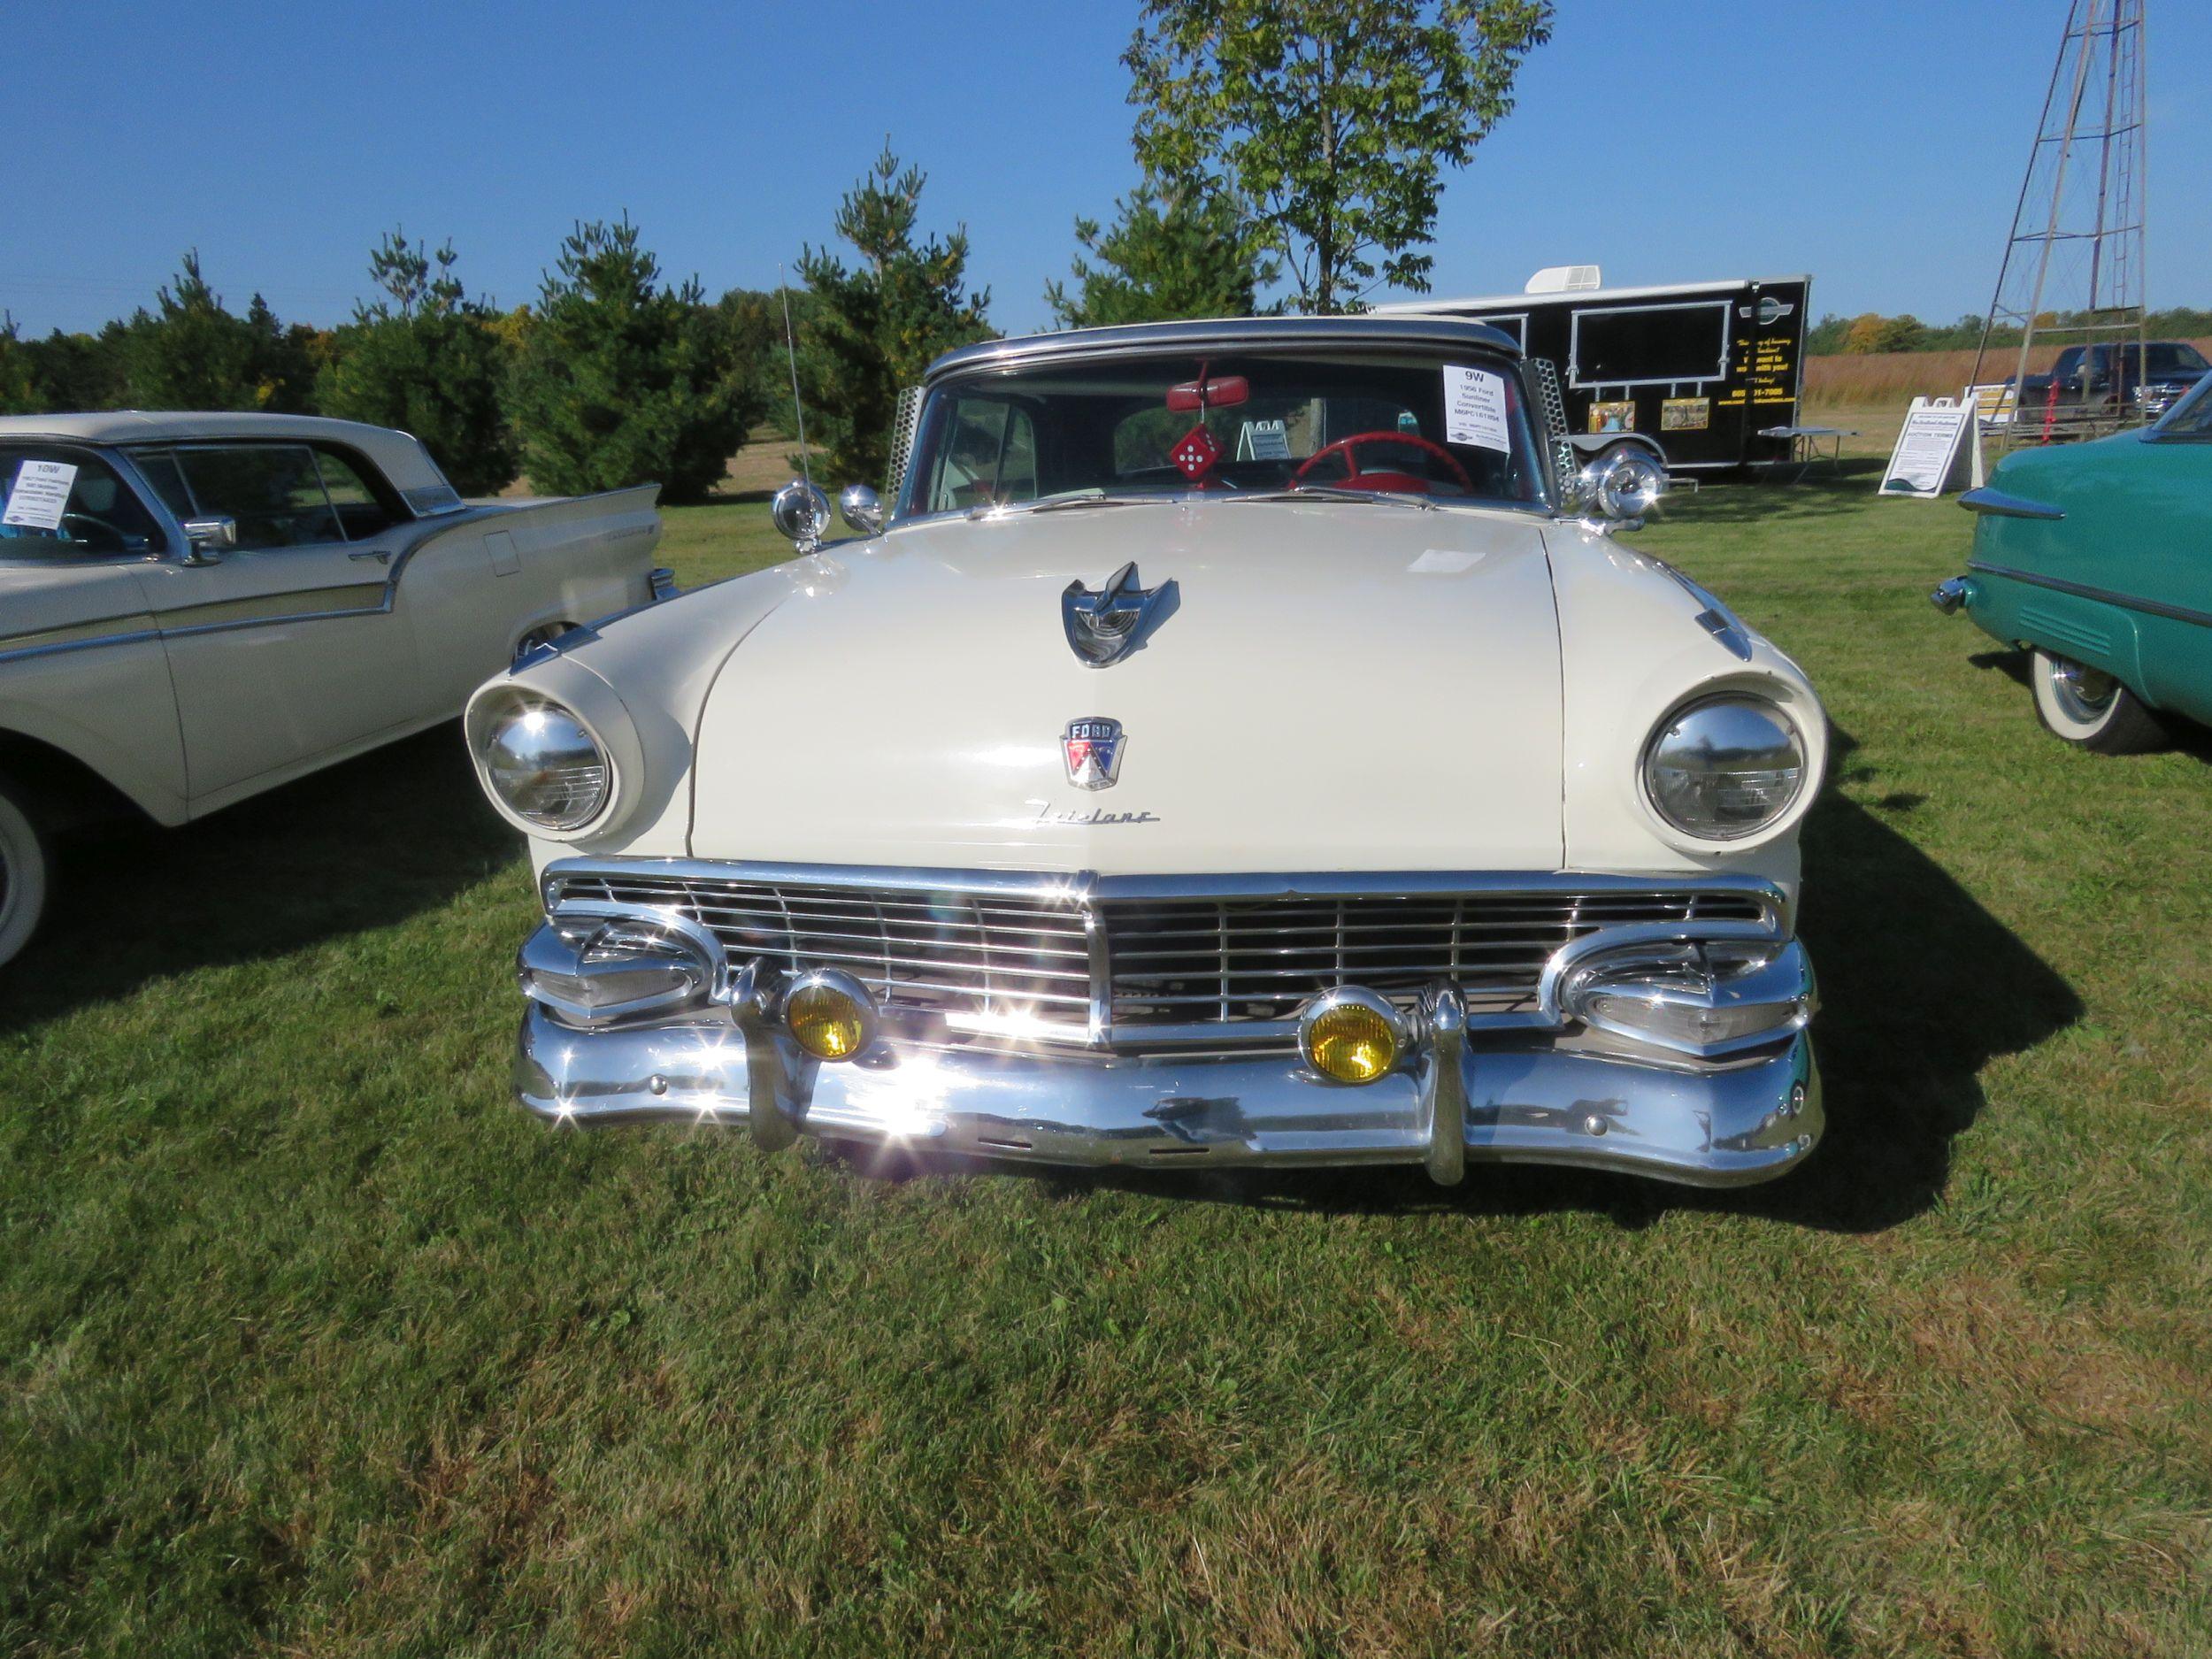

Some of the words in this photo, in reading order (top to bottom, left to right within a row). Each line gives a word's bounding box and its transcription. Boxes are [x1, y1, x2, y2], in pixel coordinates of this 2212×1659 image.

[1465, 371, 1484, 382] 9W
[1479, 388, 1494, 396] Ford
[1457, 401, 1496, 412] Convertible
[1071, 723, 1112, 739] FORD
[1025, 798, 1161, 825] Fairlane
